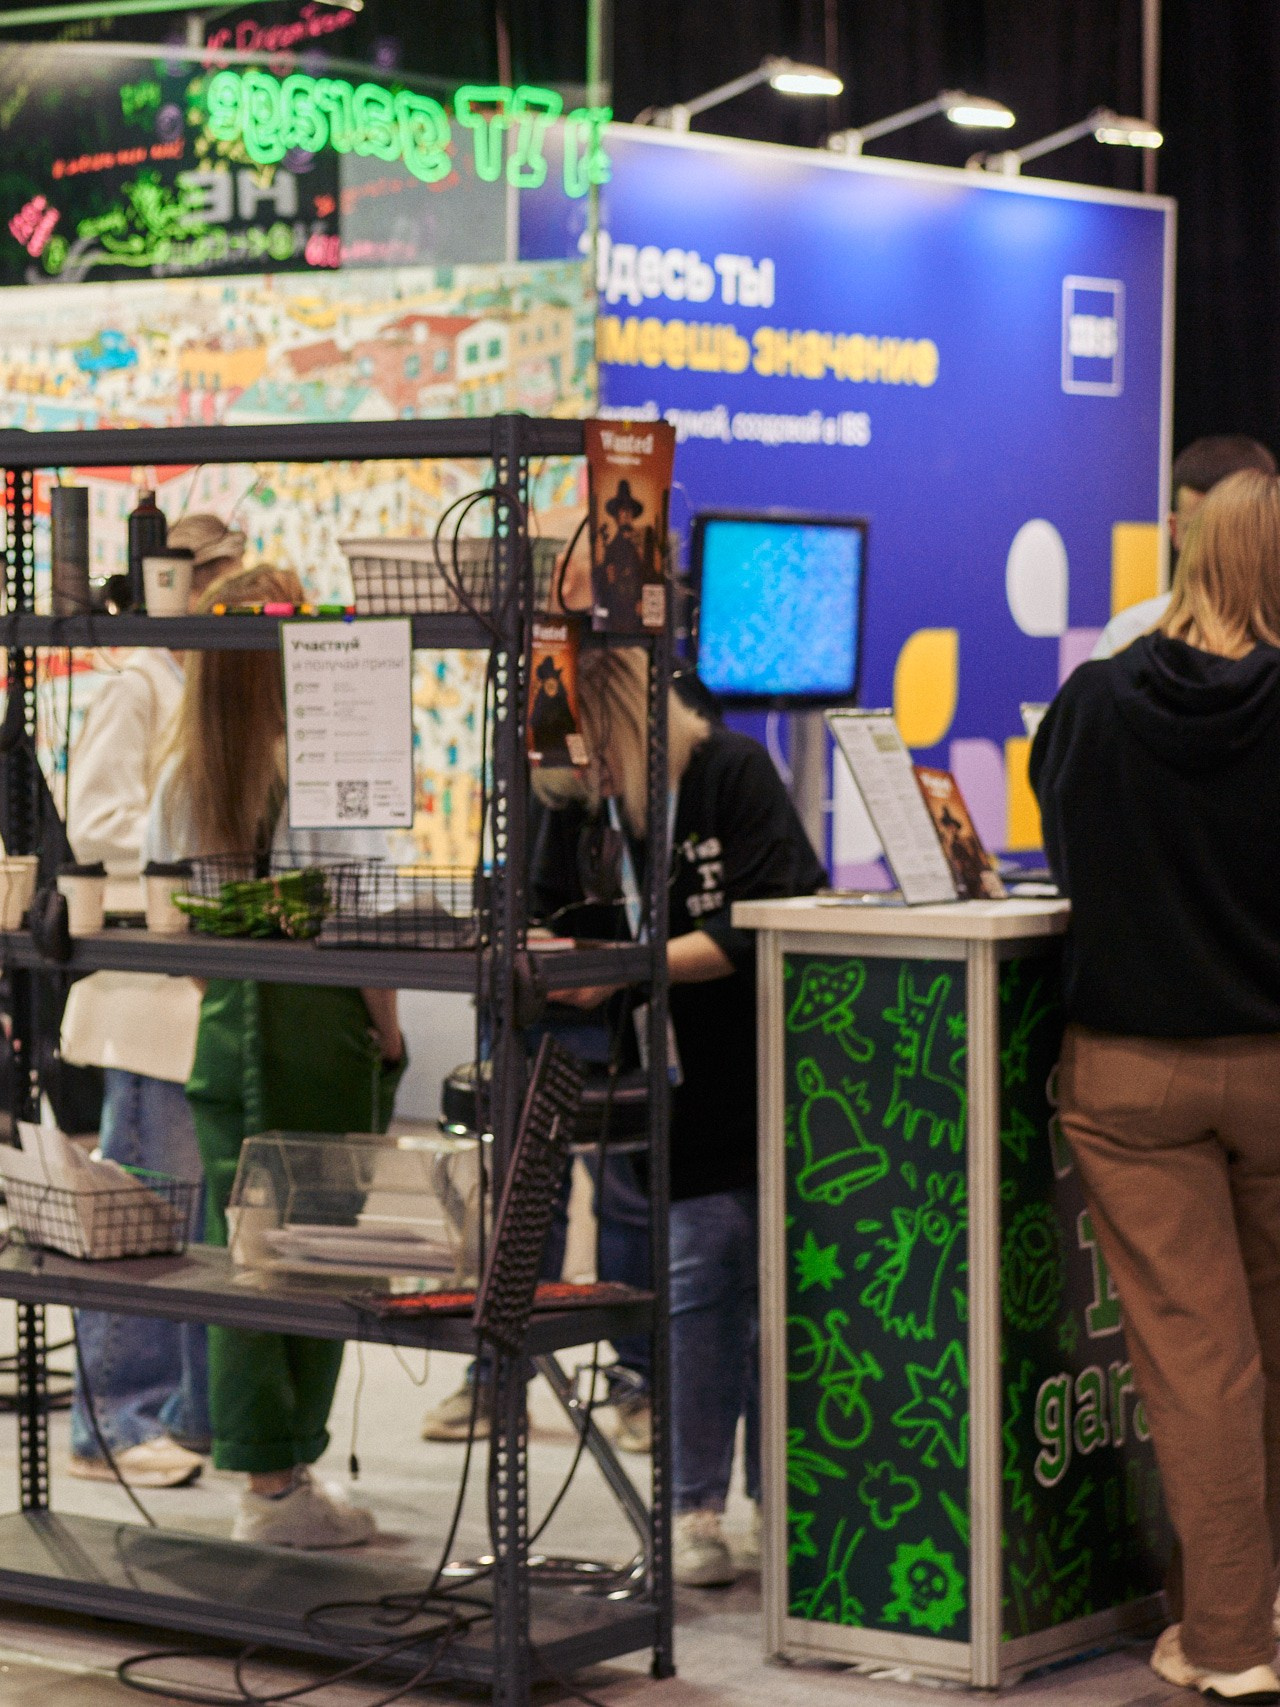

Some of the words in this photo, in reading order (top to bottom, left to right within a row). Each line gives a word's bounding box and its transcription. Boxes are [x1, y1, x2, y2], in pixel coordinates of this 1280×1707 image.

[715, 253, 775, 308] ты
[753, 326, 940, 388] значение
[1033, 1361, 1152, 1488] gar
